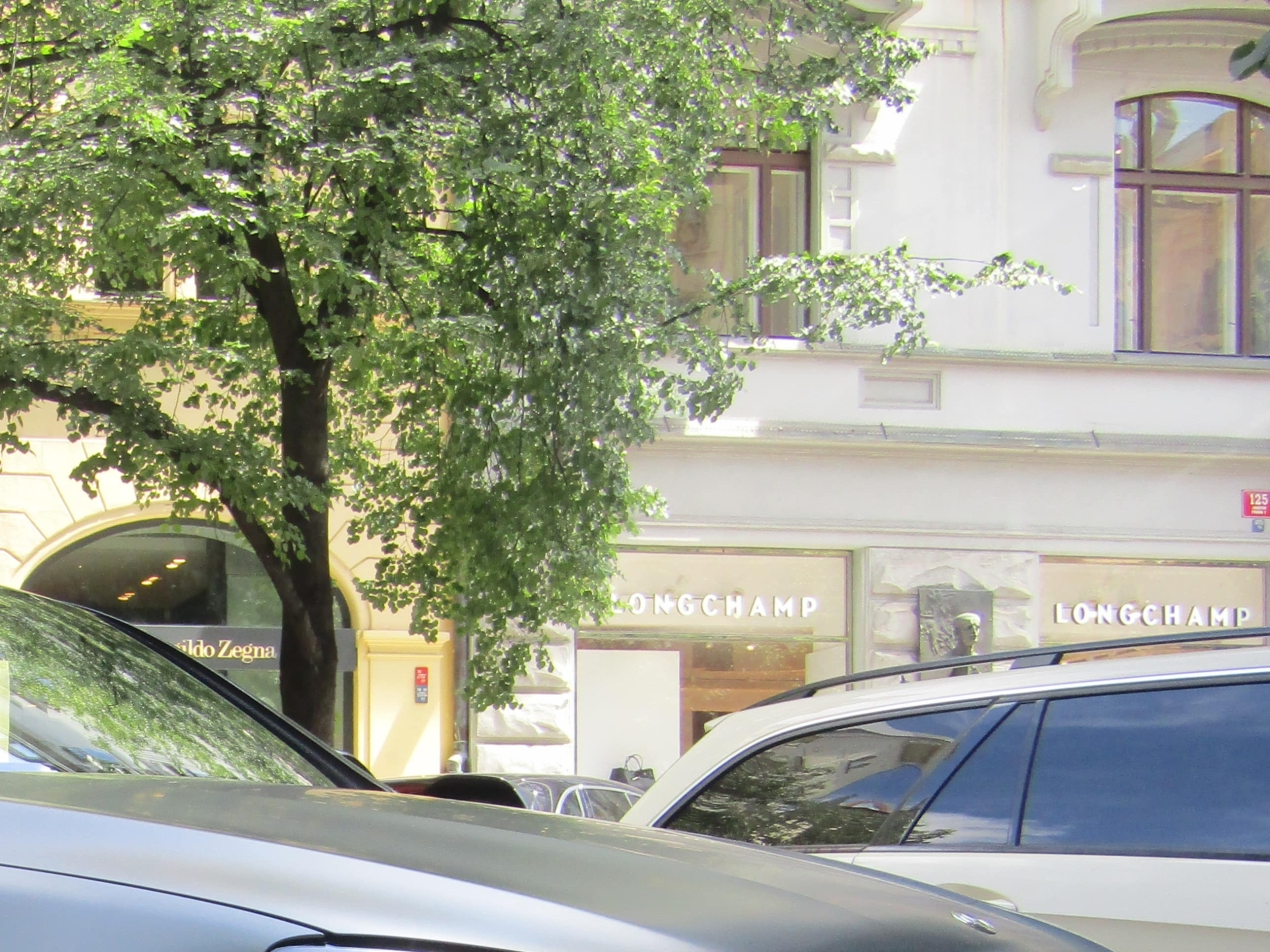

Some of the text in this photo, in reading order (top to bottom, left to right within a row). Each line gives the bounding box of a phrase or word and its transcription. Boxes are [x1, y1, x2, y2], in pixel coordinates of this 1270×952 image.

[1250, 493, 1268, 505] 125
[610, 592, 818, 618] LONGCHAMP
[1055, 602, 1251, 627] LONGCHAMP
[217, 639, 277, 664] Zegna
